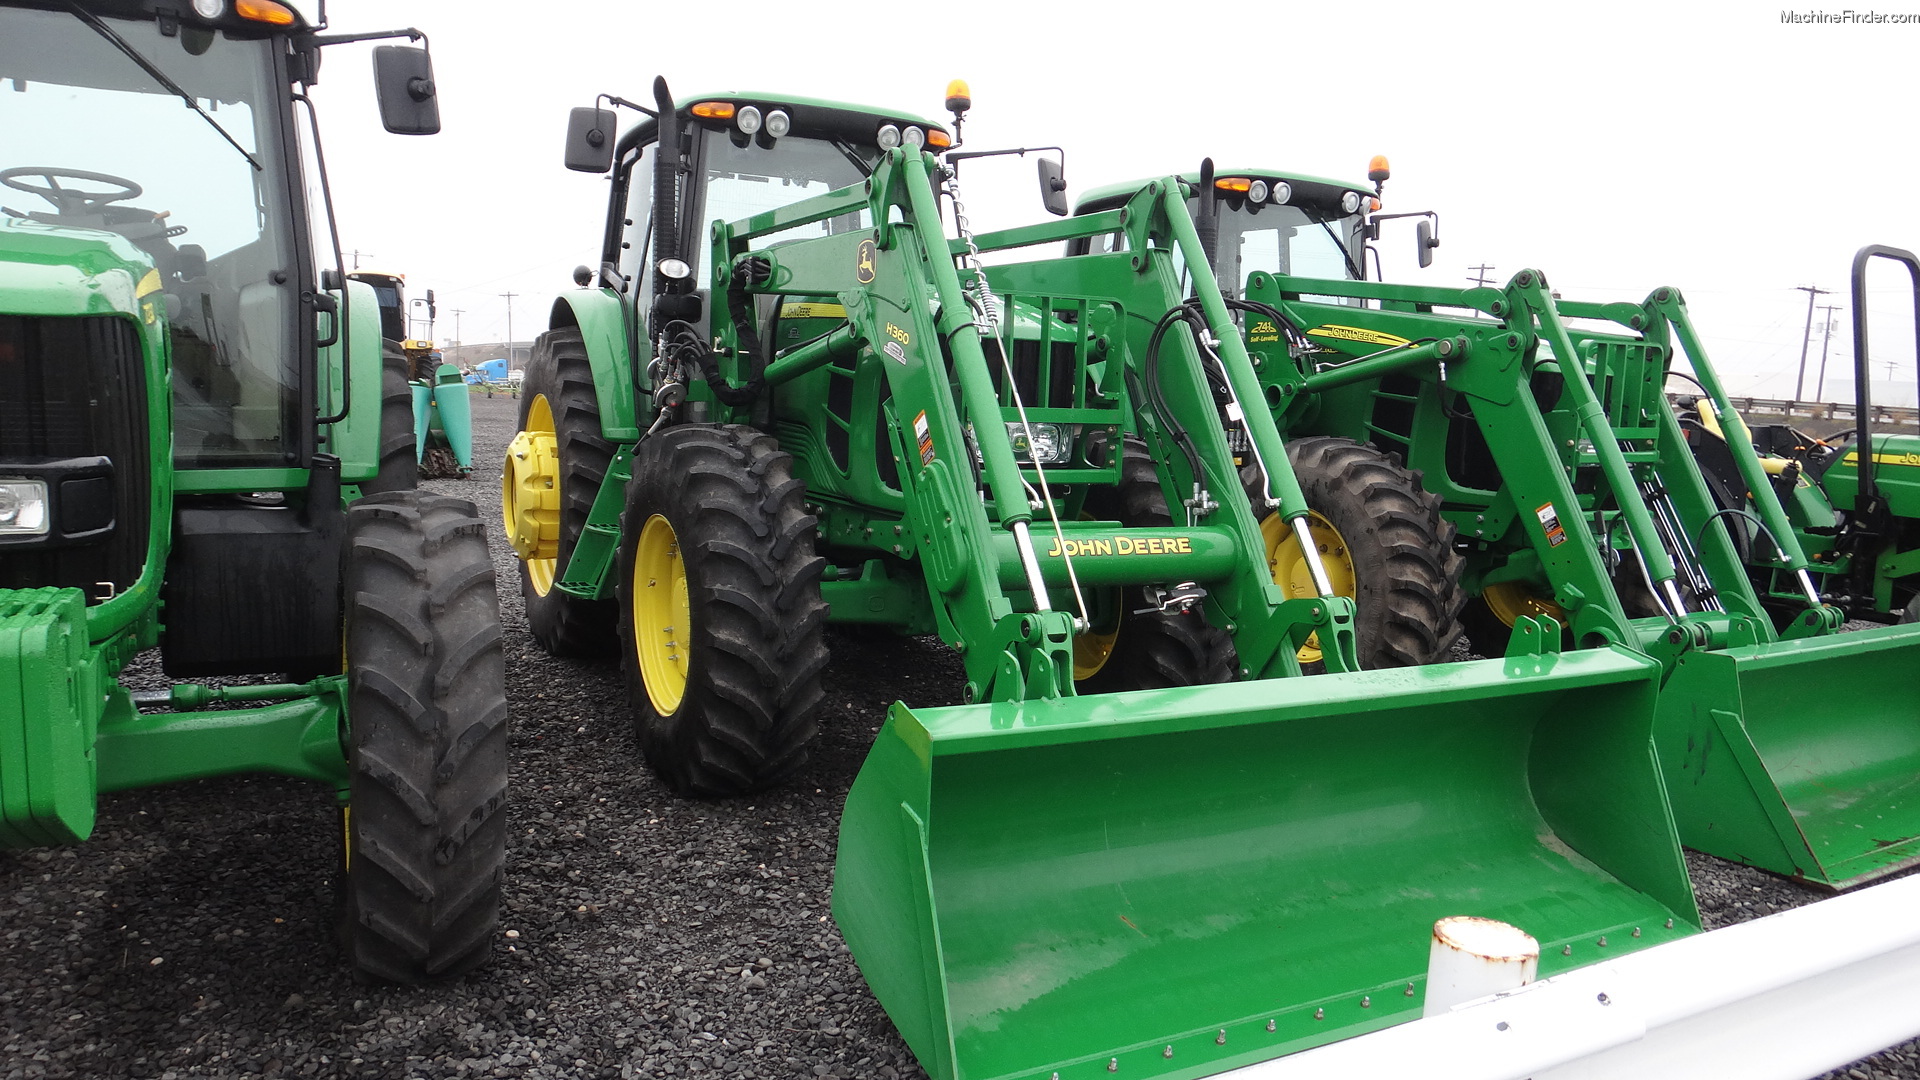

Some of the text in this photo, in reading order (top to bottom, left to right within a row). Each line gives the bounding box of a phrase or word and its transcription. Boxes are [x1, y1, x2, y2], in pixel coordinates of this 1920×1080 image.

[886, 321, 909, 345] H360
[1257, 322, 1271, 332] 741
[1328, 327, 1378, 341] JOHN DEERE
[1049, 536, 1192, 557] JOHN DEERE
